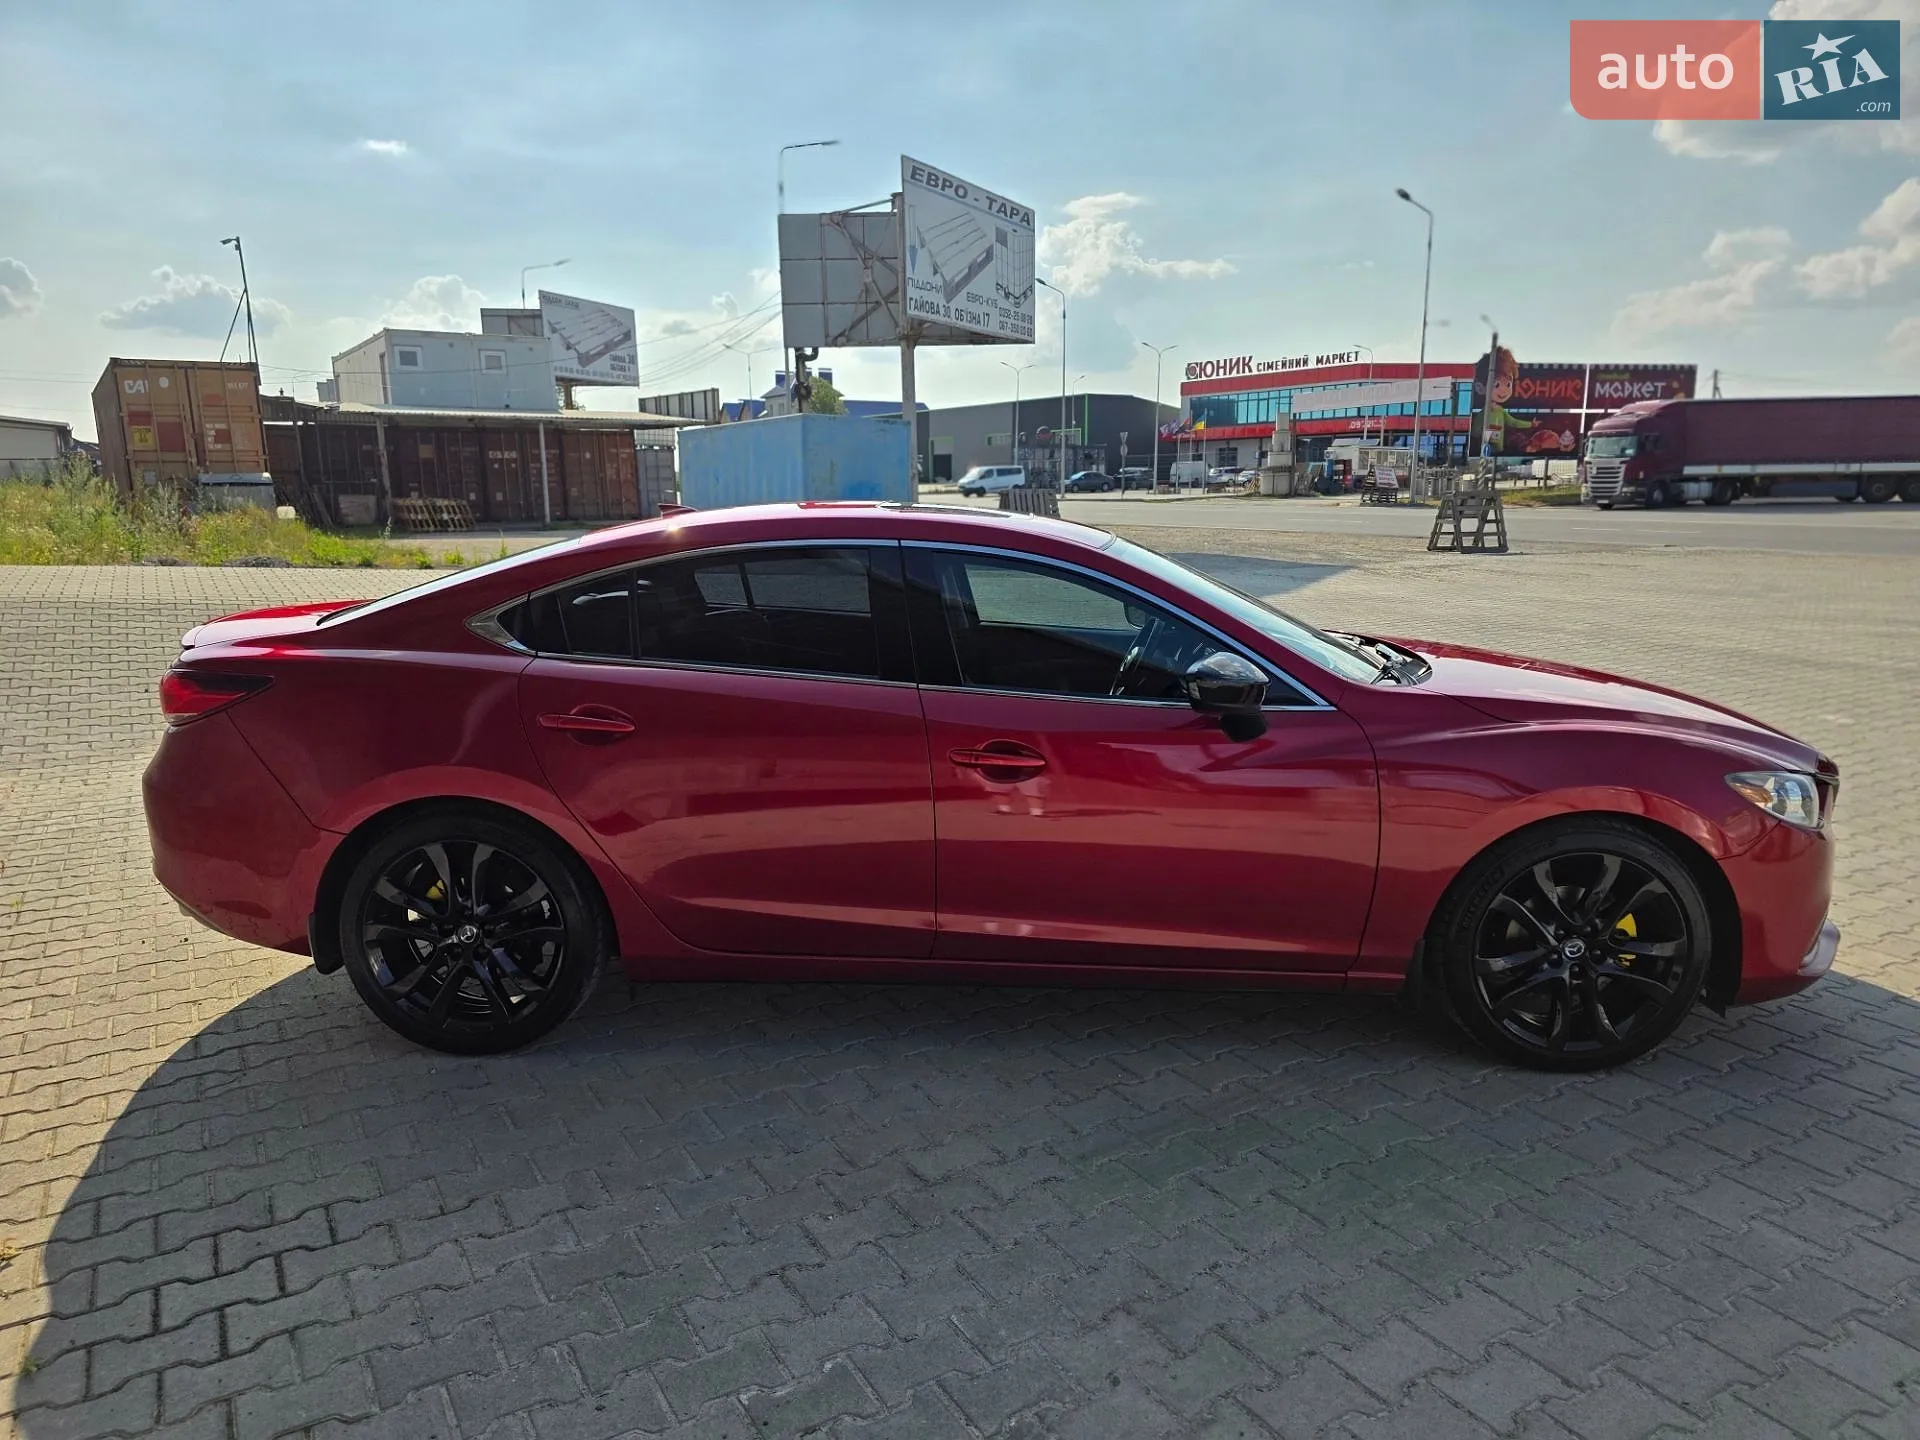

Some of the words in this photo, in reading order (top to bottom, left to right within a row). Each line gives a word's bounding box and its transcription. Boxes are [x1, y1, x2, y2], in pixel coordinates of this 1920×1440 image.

[910, 165, 968, 200] ЕВРО
[985, 195, 1031, 226] ТАРА
[909, 296, 941, 316] ГАЙОВА
[983, 311, 991, 328] 17
[1199, 355, 1253, 379] ЮНИК
[1256, 354, 1309, 373] СІМЕЙНИЙ
[1315, 350, 1361, 366] МАРКЕТ
